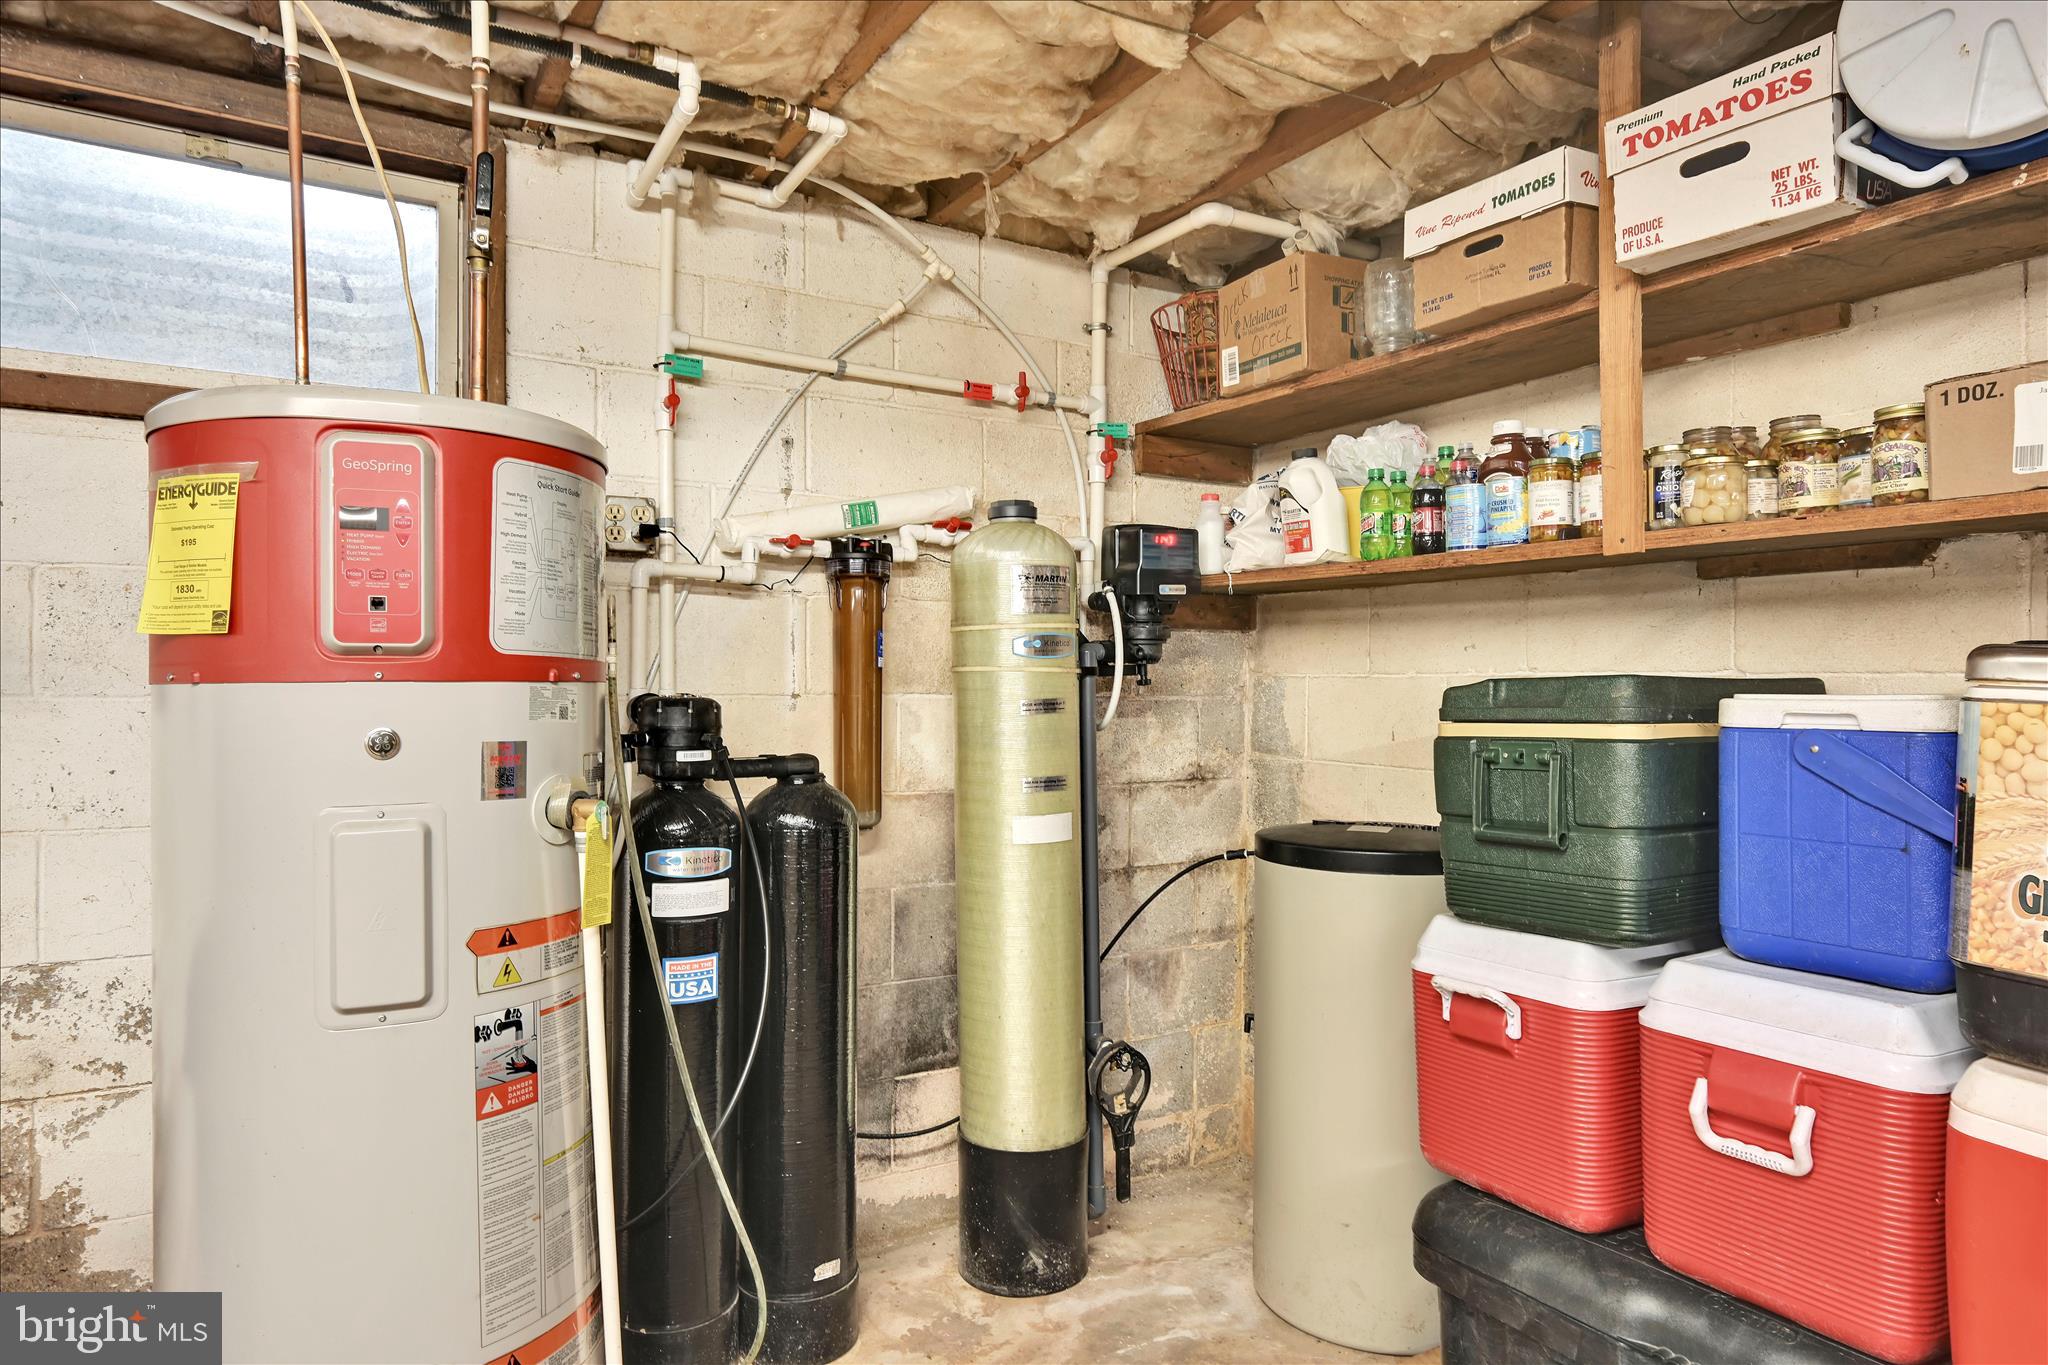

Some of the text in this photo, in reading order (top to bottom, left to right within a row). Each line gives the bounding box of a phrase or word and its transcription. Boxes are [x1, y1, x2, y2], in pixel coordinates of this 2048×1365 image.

[1732, 45, 1821, 88] Hand Packed
[1616, 109, 1664, 135] Premium
[1622, 68, 1814, 158] TOMATOES
[1771, 157, 1820, 182] NET WT.
[1775, 173, 1817, 194] 25 LBS.
[1866, 180, 1892, 200] USA
[1416, 172, 1556, 239] Vine Ripened TOMATOES
[1771, 185, 1822, 209] 11.34 KG
[1622, 217, 1664, 240] PRODUCE
[1623, 236, 1664, 254] OF U.S.A.
[1528, 261, 1552, 274] PRODUCE
[1536, 270, 1552, 280] U.S.A.
[1242, 303, 1288, 330] Melaleuca
[1940, 381, 2004, 406] 1 DOZ.
[342, 458, 413, 475] GeoSpring
[158, 481, 238, 501] ENERGYGUIDE
[537, 481, 580, 498] Quick Start Guide
[1656, 484, 1681, 492] ONIO
[180, 538, 197, 546] $195
[176, 584, 195, 593] 1830
[1035, 575, 1068, 583] MARTIN
[2018, 874, 2048, 916] G
[670, 979, 713, 998] USA
[508, 1080, 533, 1092] DANGER
[508, 1086, 533, 1099] DANGER
[507, 1092, 534, 1106] PELIGRO
